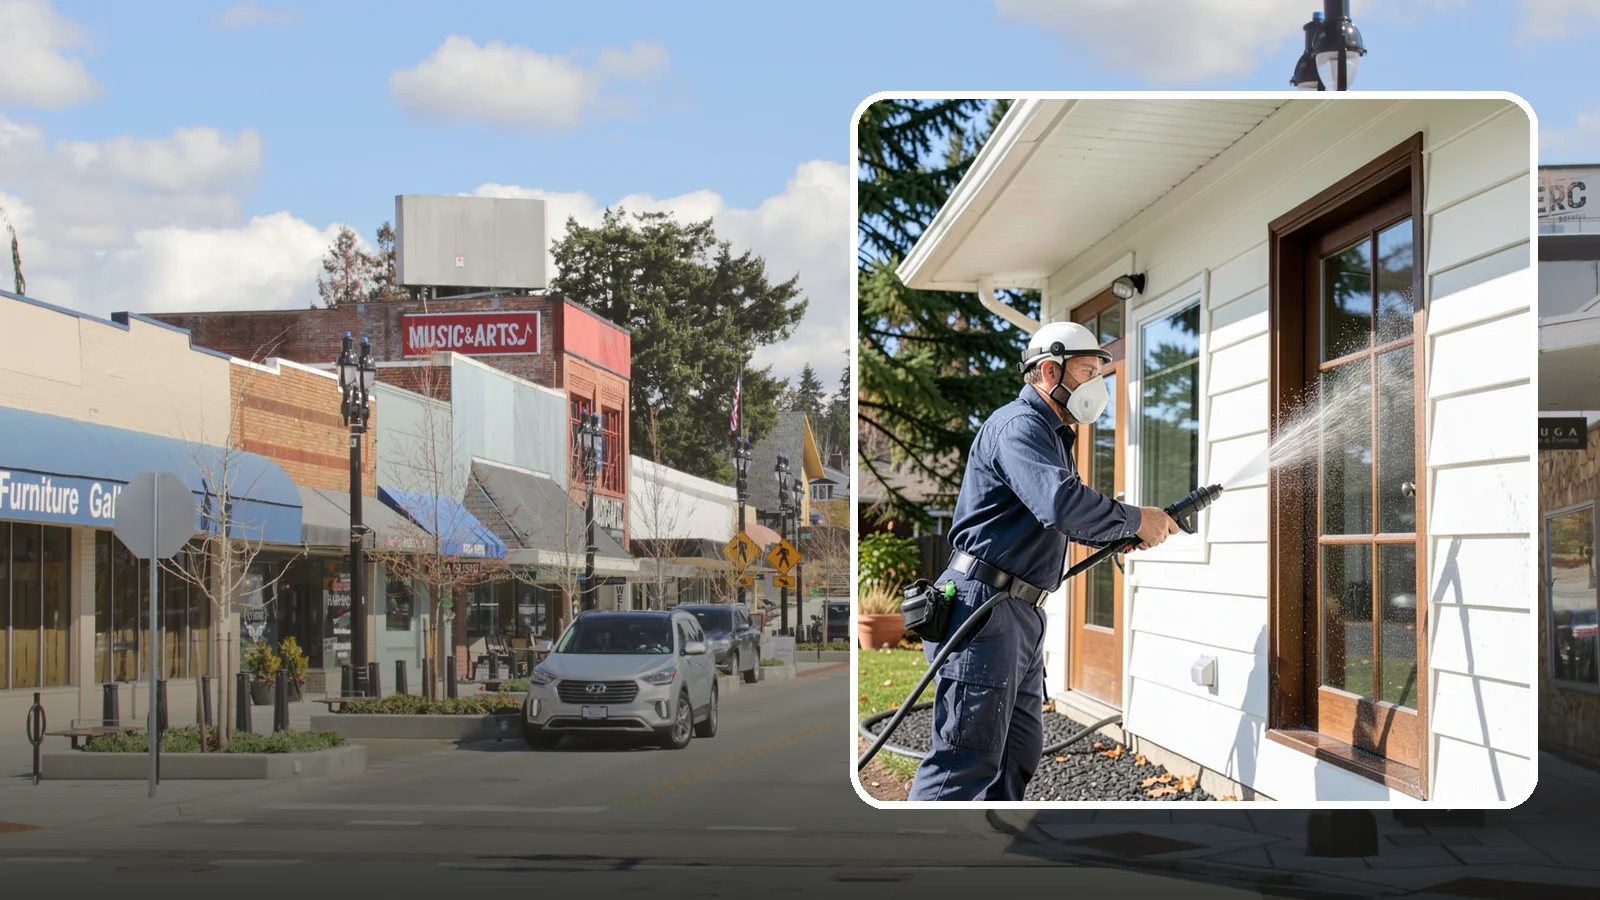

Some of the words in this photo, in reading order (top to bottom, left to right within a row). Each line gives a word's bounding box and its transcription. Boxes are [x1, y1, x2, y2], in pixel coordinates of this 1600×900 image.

[408, 323, 519, 349] MUSIC&ARTS
[0, 471, 79, 515] Furniture
[89, 482, 122, 519] Gal
[453, 563, 479, 574] SUSHI
